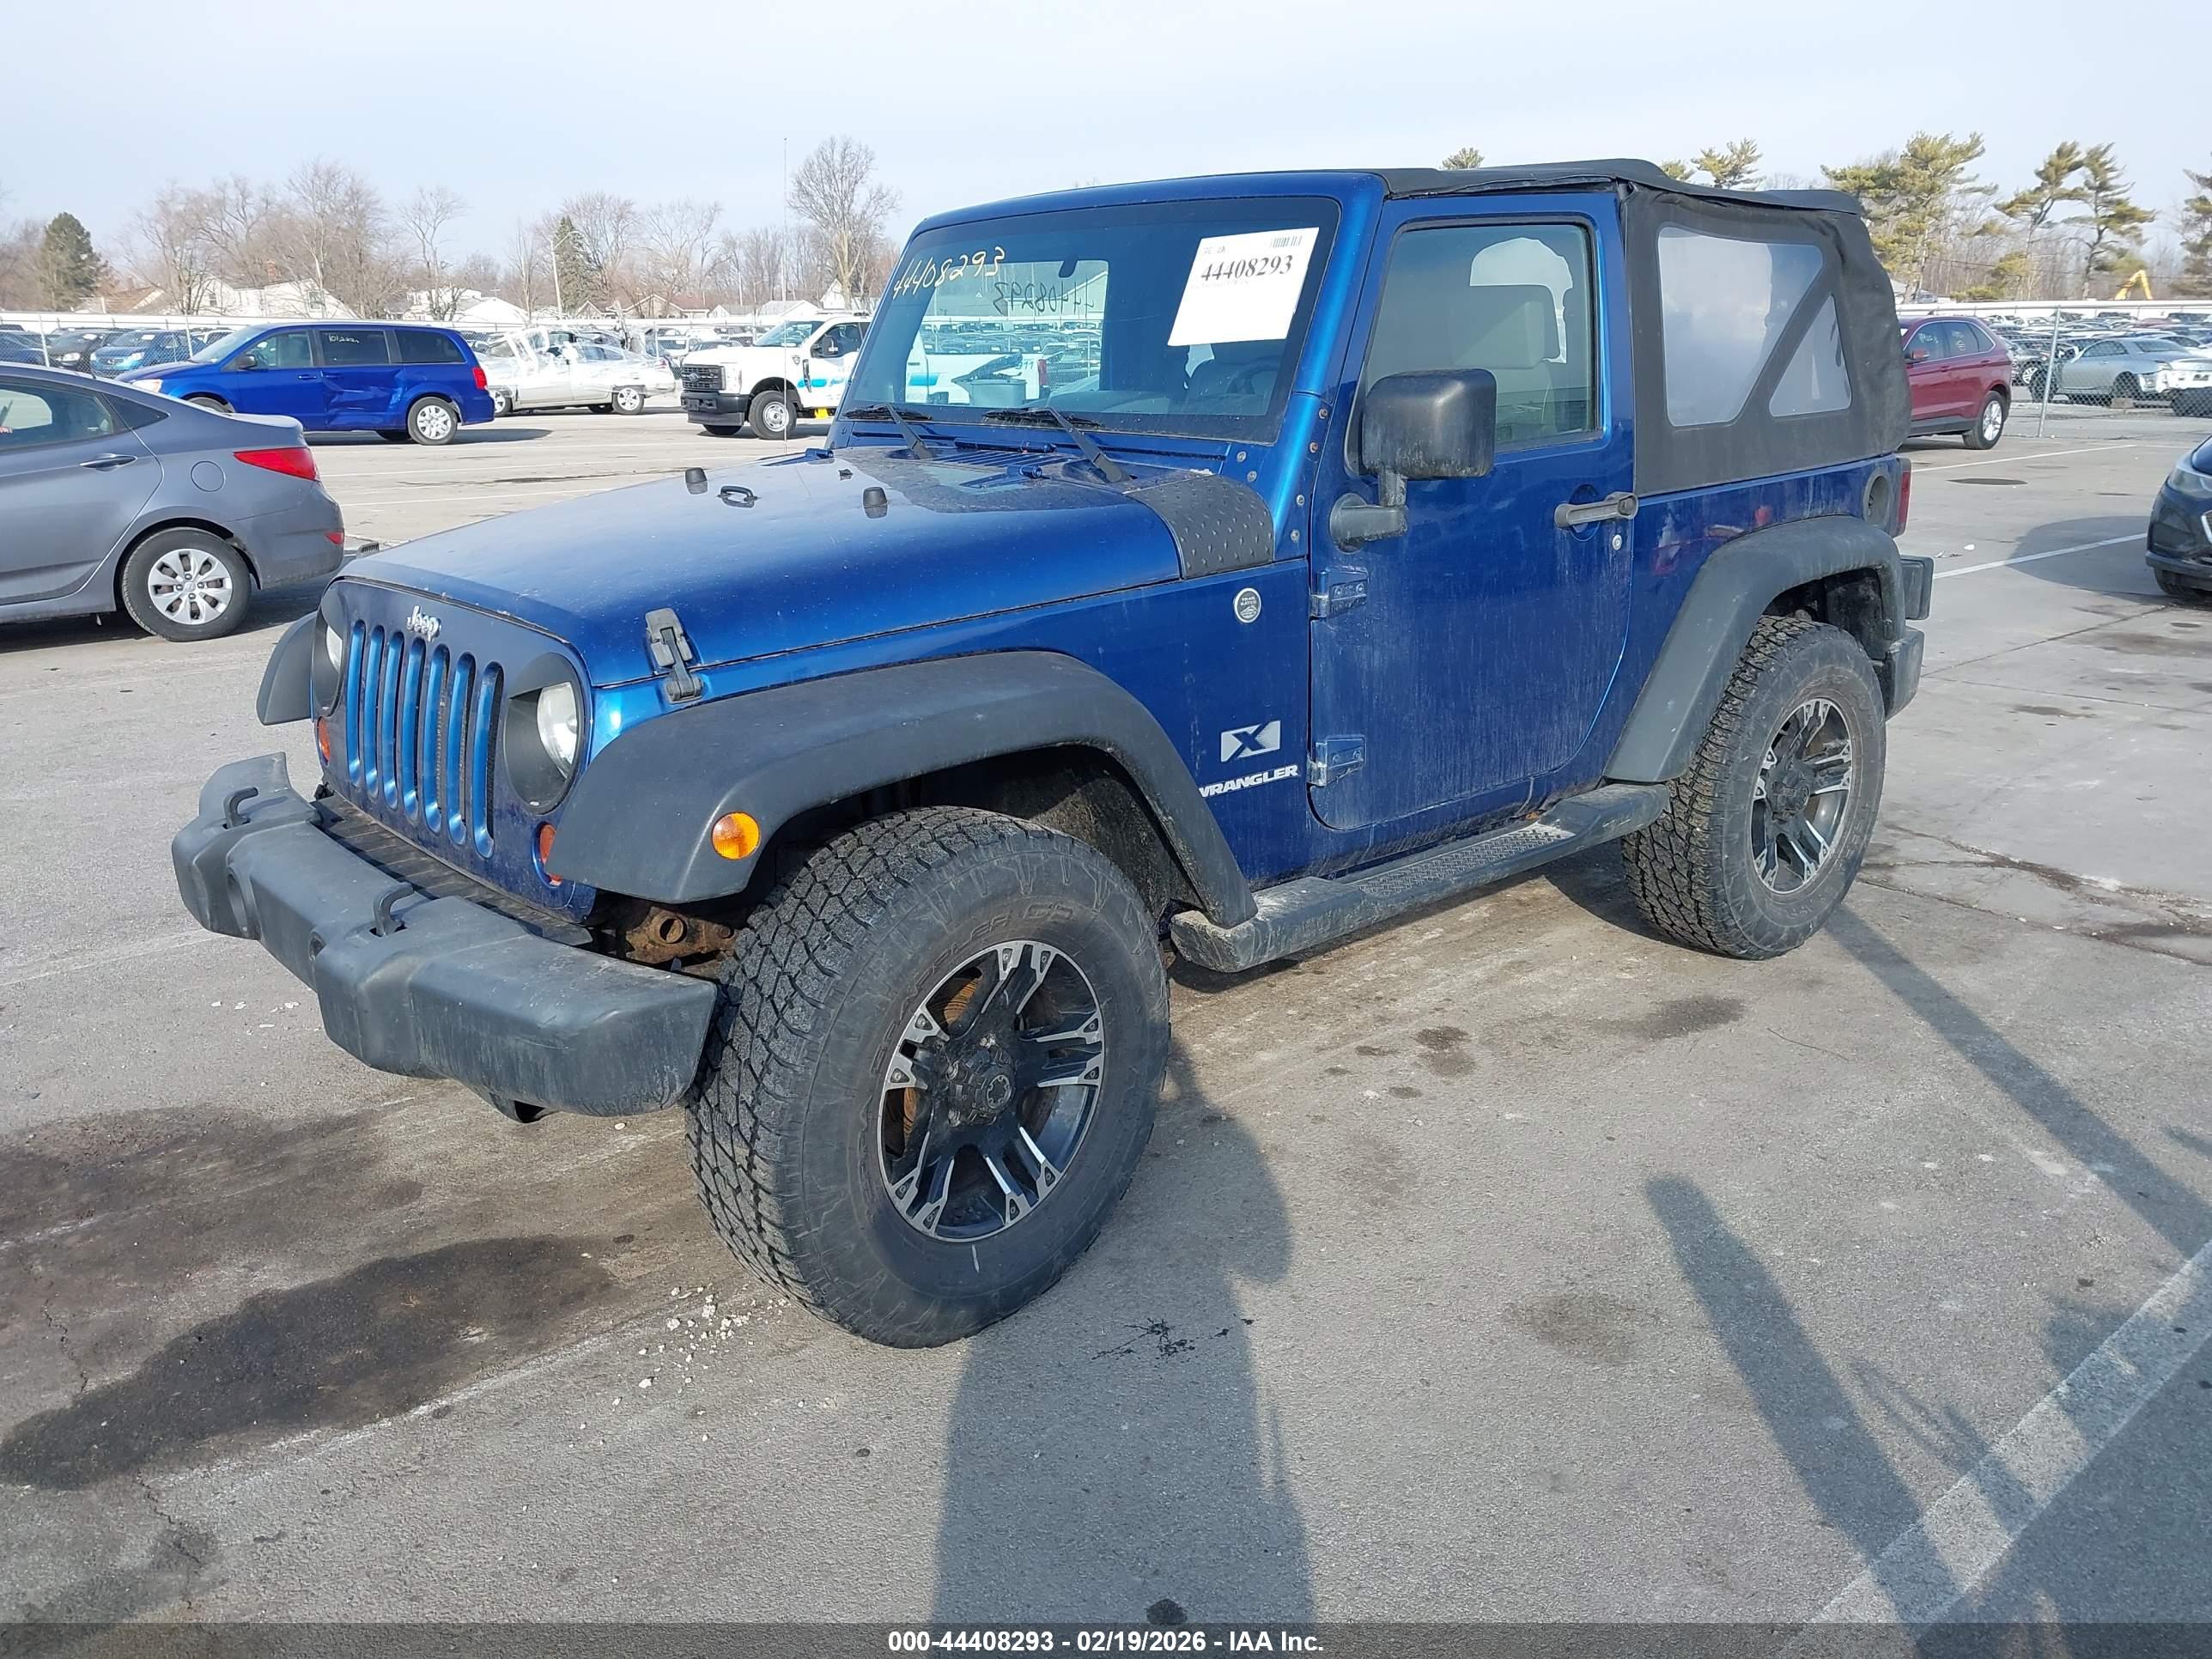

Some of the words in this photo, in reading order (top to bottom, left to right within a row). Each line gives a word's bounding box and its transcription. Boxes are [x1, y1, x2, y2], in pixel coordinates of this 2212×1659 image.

[892, 246, 1006, 300] 44408293
[1200, 254, 1293, 282] 44408293
[405, 605, 440, 642] Jeep
[1221, 720, 1278, 763] X
